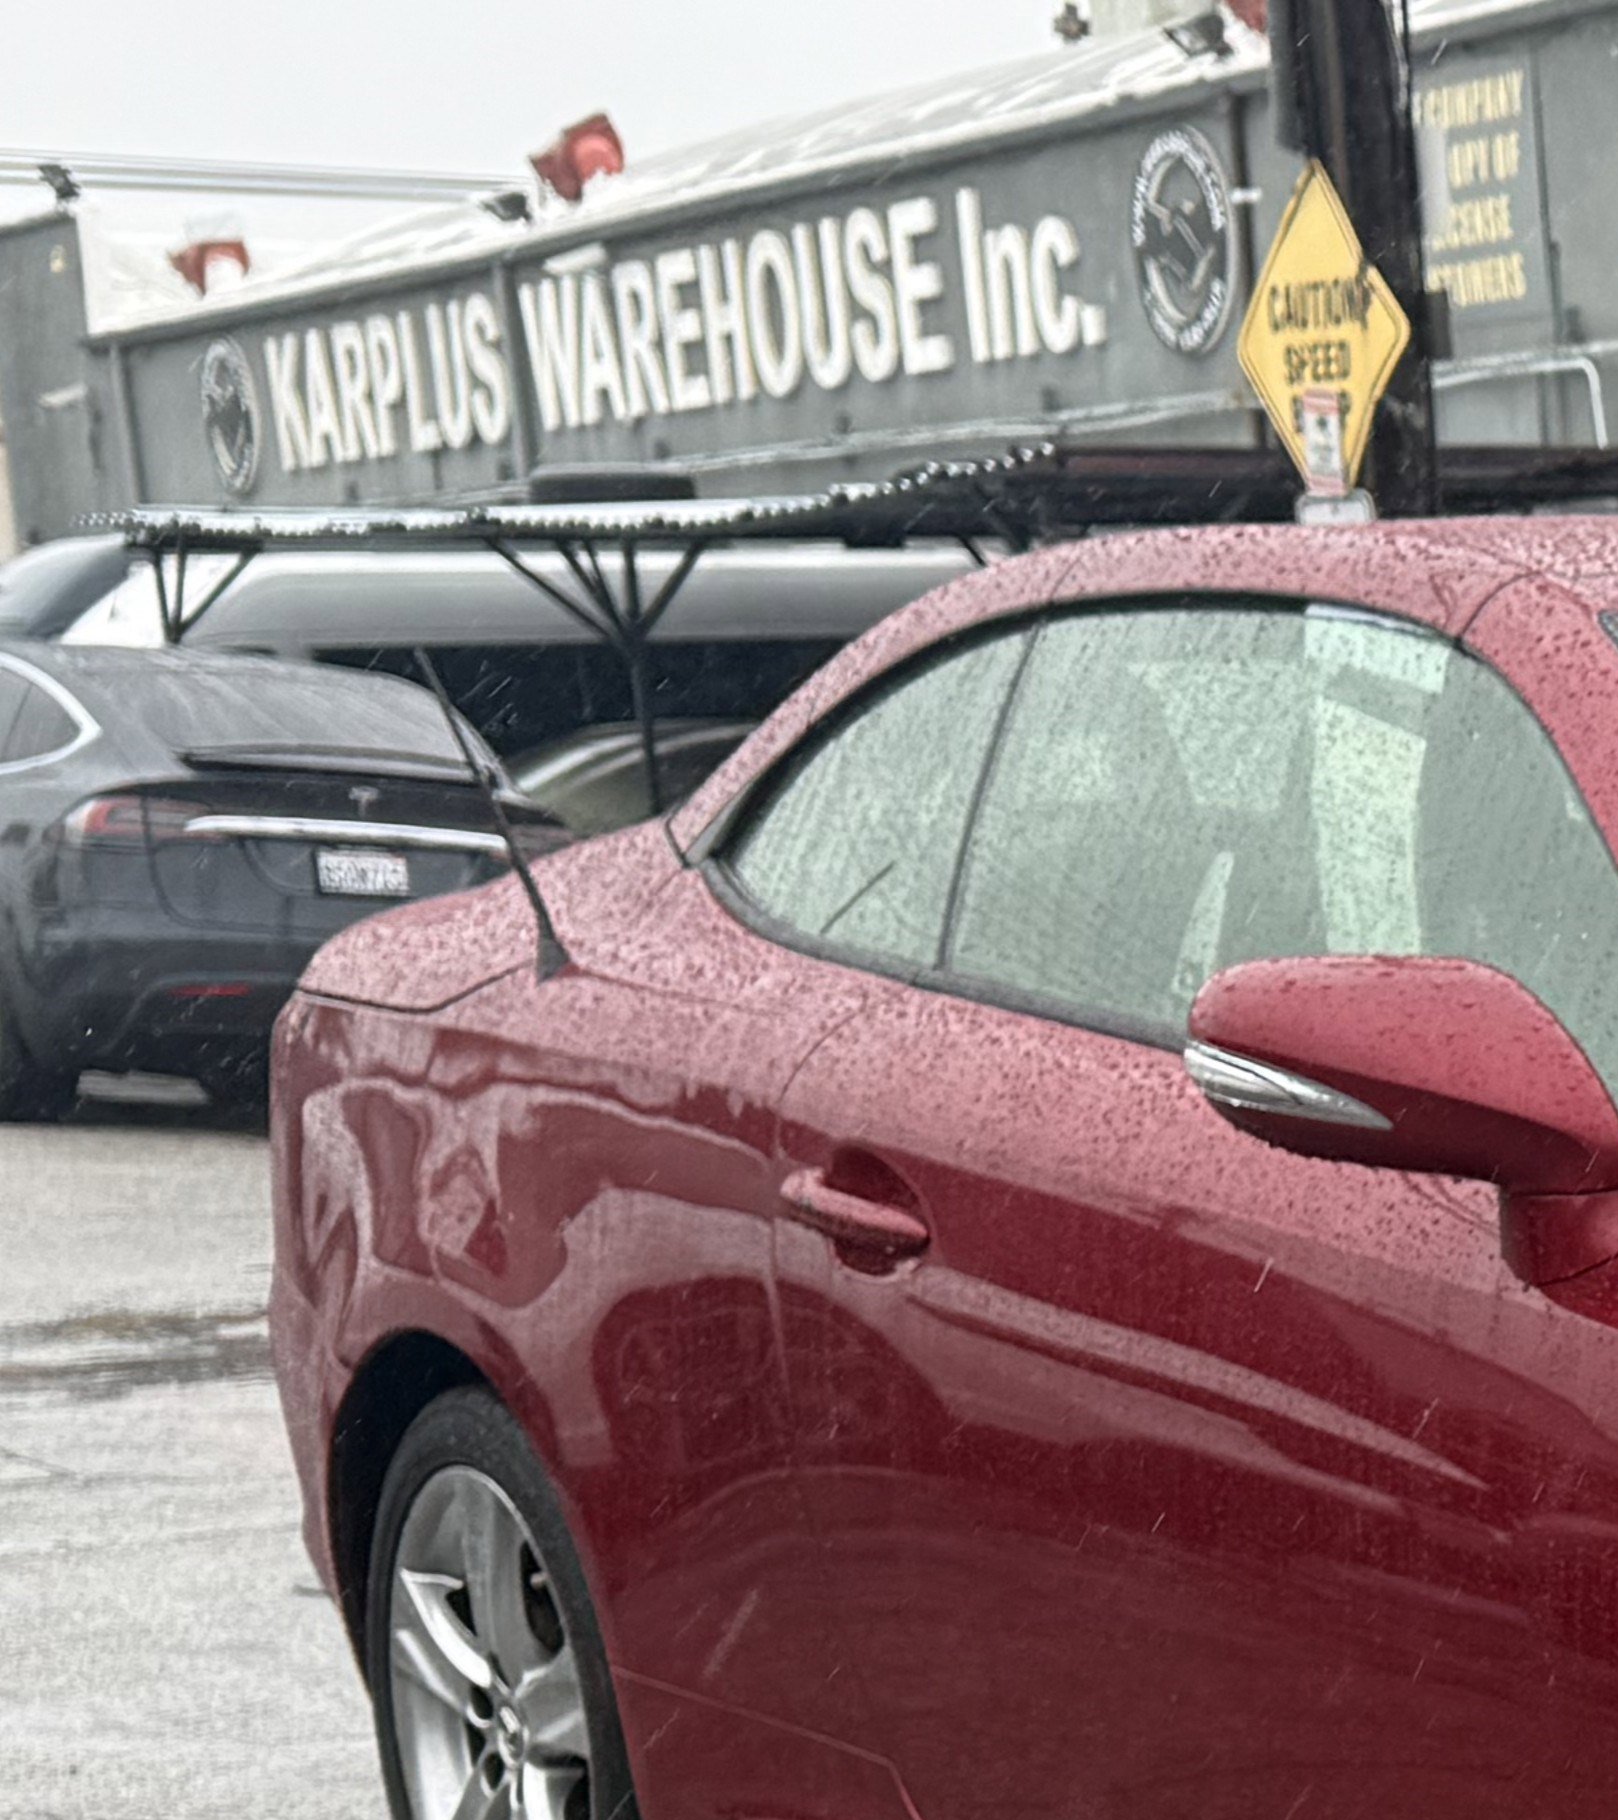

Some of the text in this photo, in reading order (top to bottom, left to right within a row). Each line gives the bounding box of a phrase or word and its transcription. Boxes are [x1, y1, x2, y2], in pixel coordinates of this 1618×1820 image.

[263, 292, 511, 472] KARPLUS
[517, 194, 956, 432] WAREHOUSE
[954, 186, 1106, 364] Inc.
[1284, 340, 1350, 385] SPEED
